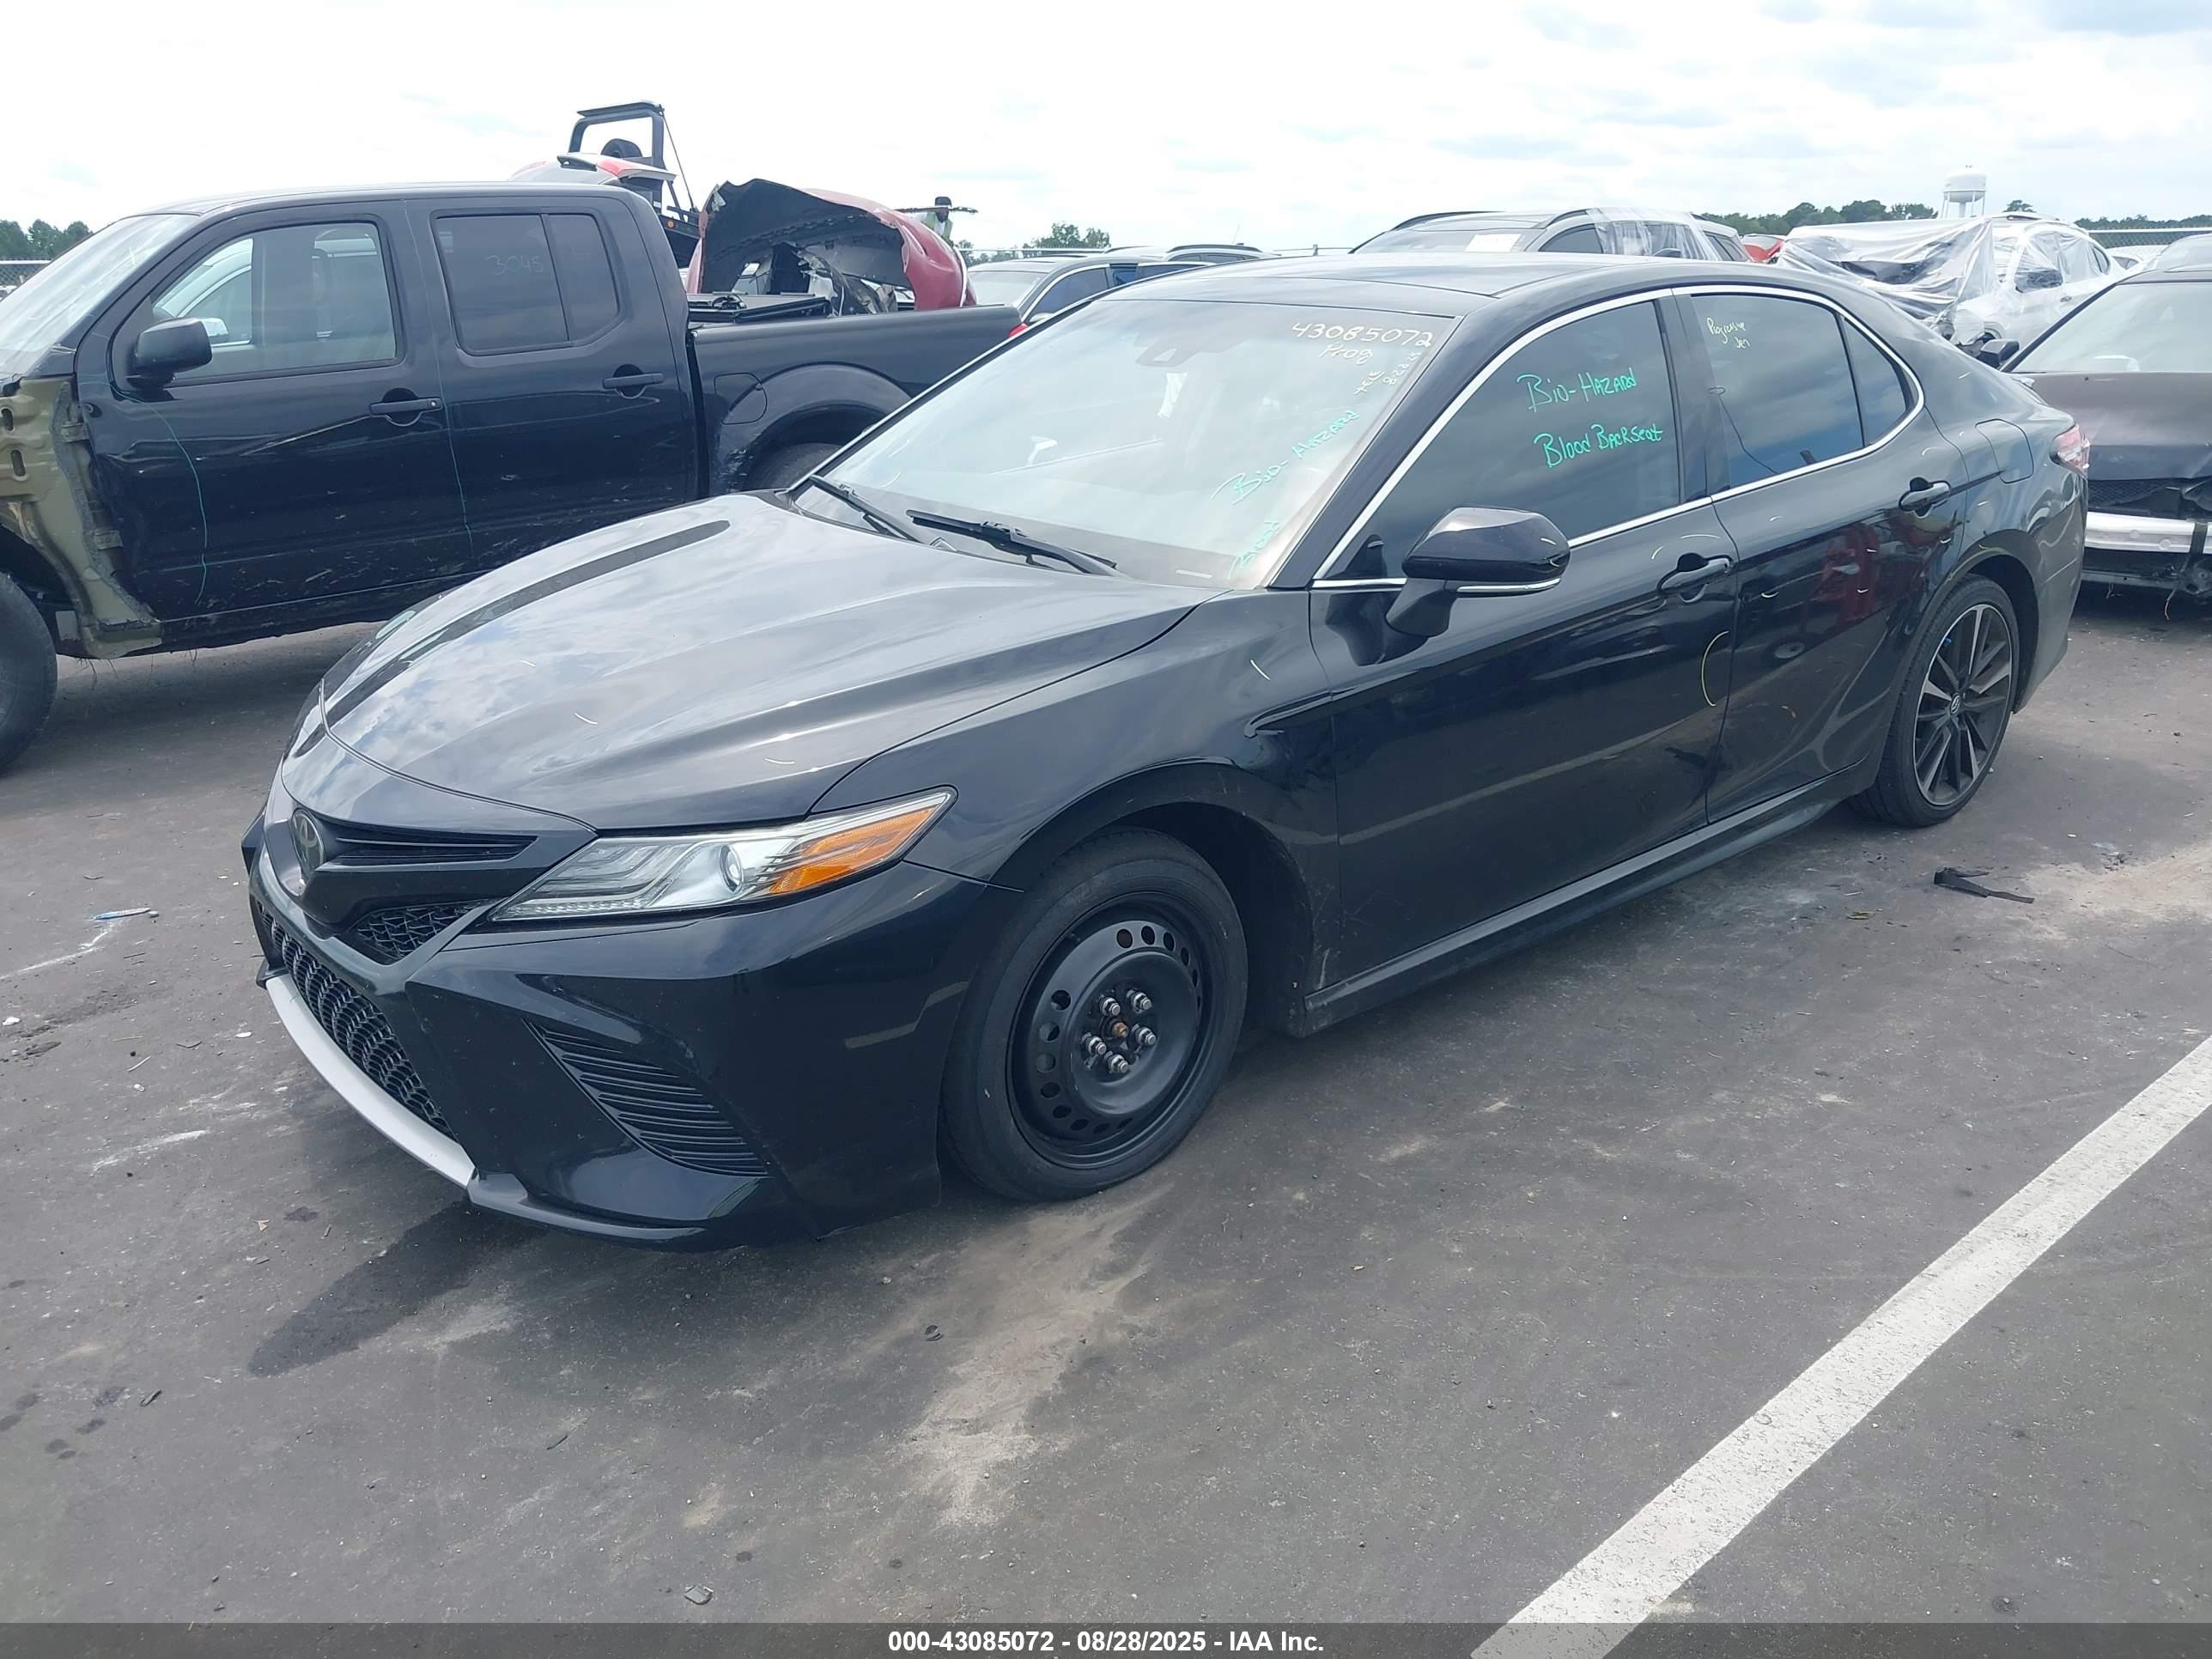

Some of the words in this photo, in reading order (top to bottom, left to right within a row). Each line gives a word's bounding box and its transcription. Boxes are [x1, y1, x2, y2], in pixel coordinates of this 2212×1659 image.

[483, 254, 544, 276] 3045
[1291, 323, 1433, 348] 43085072
[1534, 433, 1590, 468] Blood
